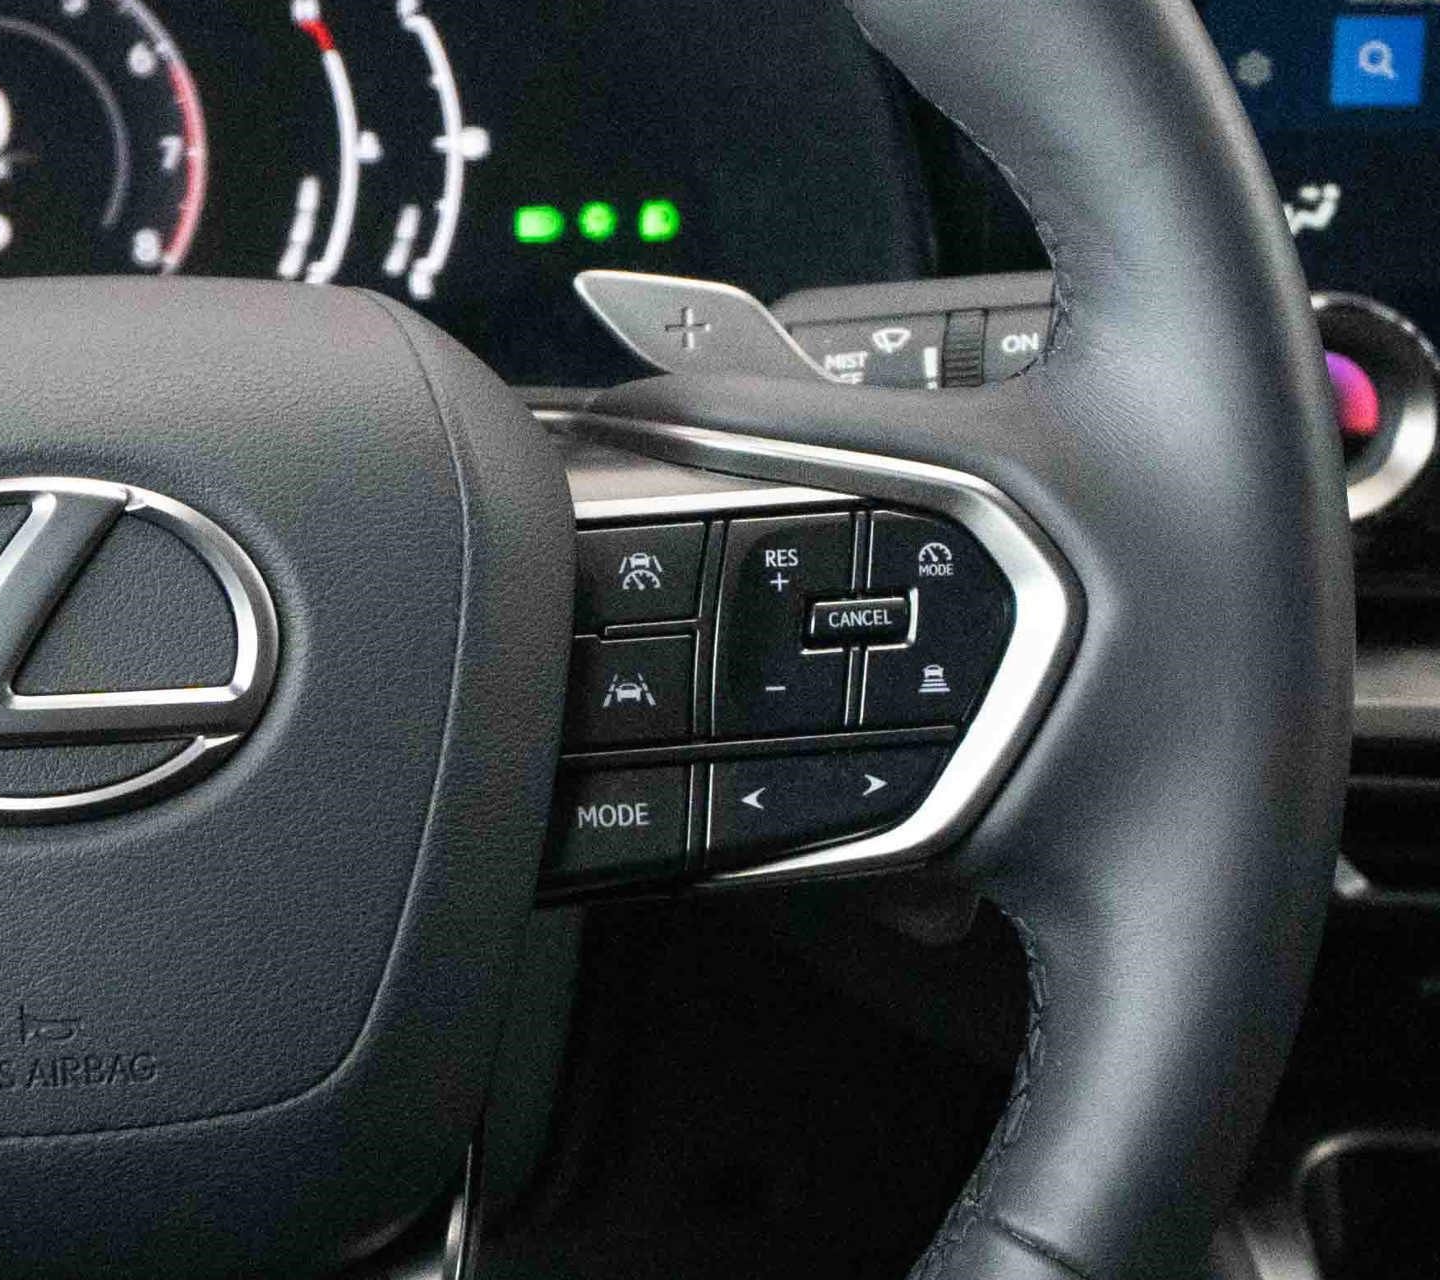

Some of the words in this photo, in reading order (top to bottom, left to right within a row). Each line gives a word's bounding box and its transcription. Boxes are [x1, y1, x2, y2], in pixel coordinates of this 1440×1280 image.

[128, 42, 158, 78] 6
[160, 135, 183, 172] 7
[133, 229, 163, 266] 8
[1001, 332, 1039, 353] ON
[825, 351, 868, 370] MIST
[765, 548, 799, 568] RES
[919, 562, 955, 577] MODE
[828, 607, 893, 628] CANCEL
[576, 803, 650, 829] MODE
[22, 1054, 159, 1091] AIRBAG
